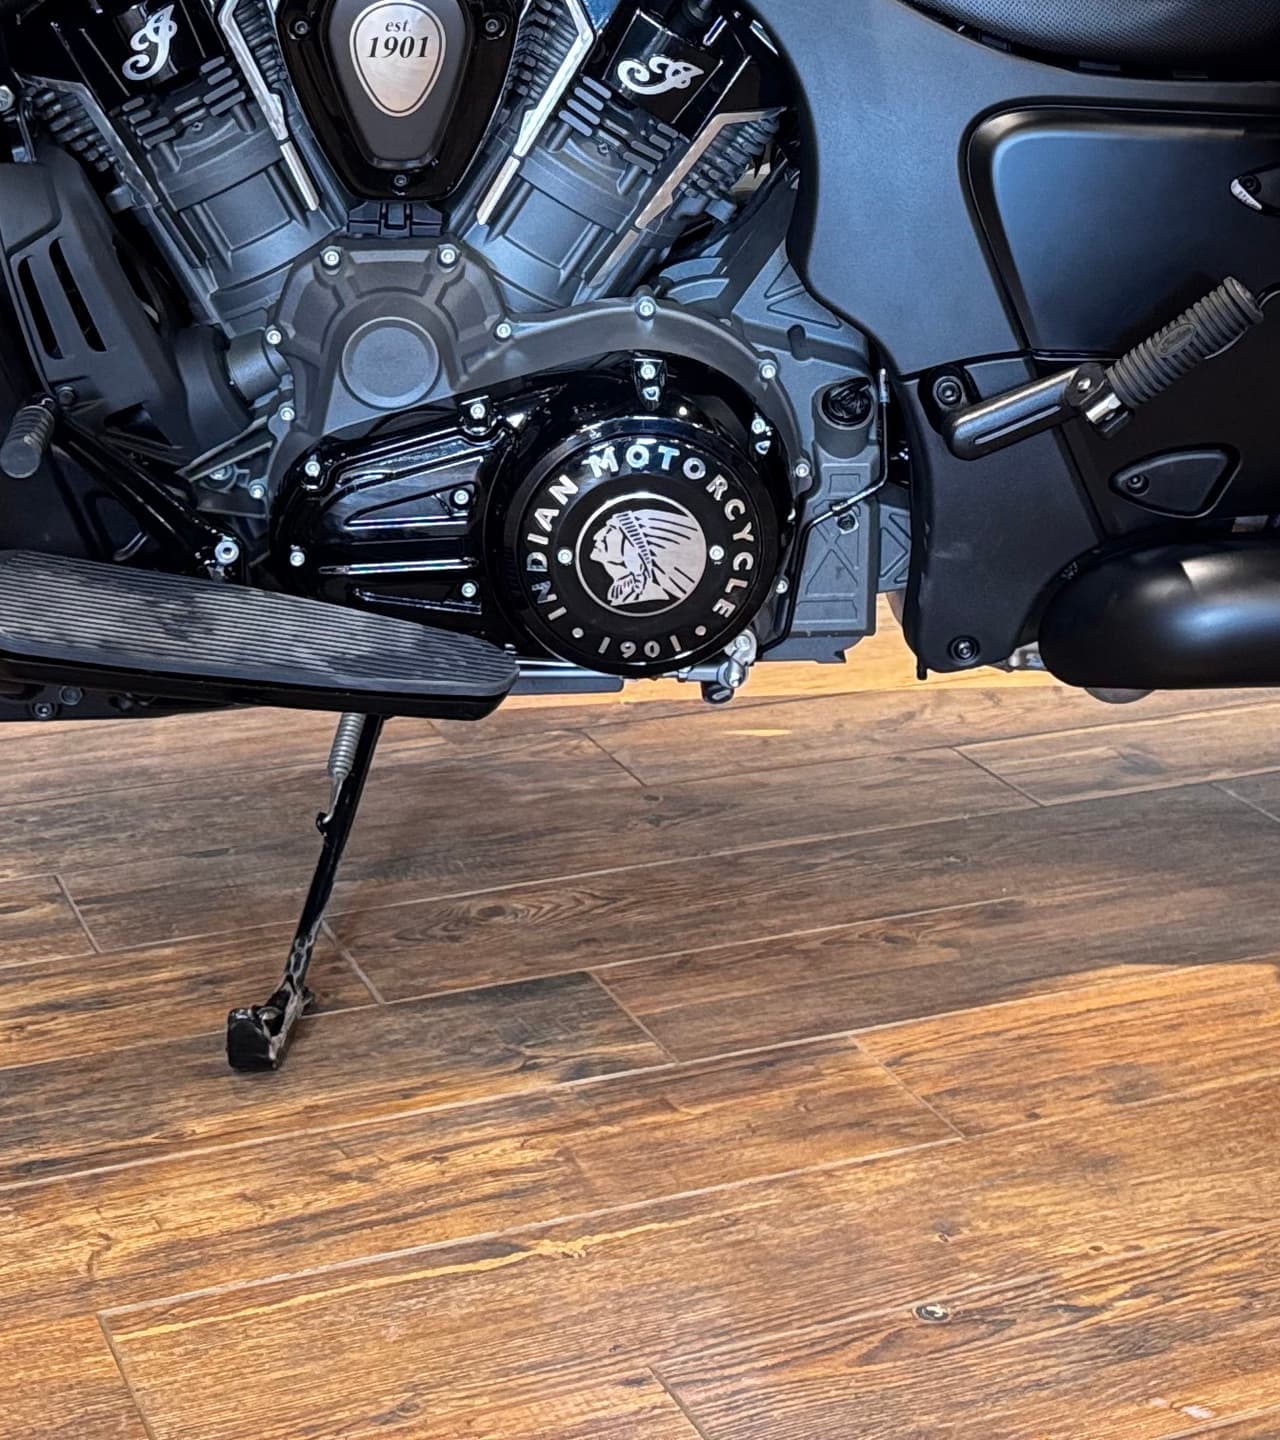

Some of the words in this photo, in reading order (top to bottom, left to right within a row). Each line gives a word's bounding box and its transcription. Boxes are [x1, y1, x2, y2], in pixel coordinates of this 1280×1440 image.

[384, 19, 412, 33] est.
[366, 35, 429, 59] 1901
[526, 474, 579, 621] INDIAN
[582, 444, 755, 619] MOTORCYCLE
[597, 635, 682, 658] 1901
